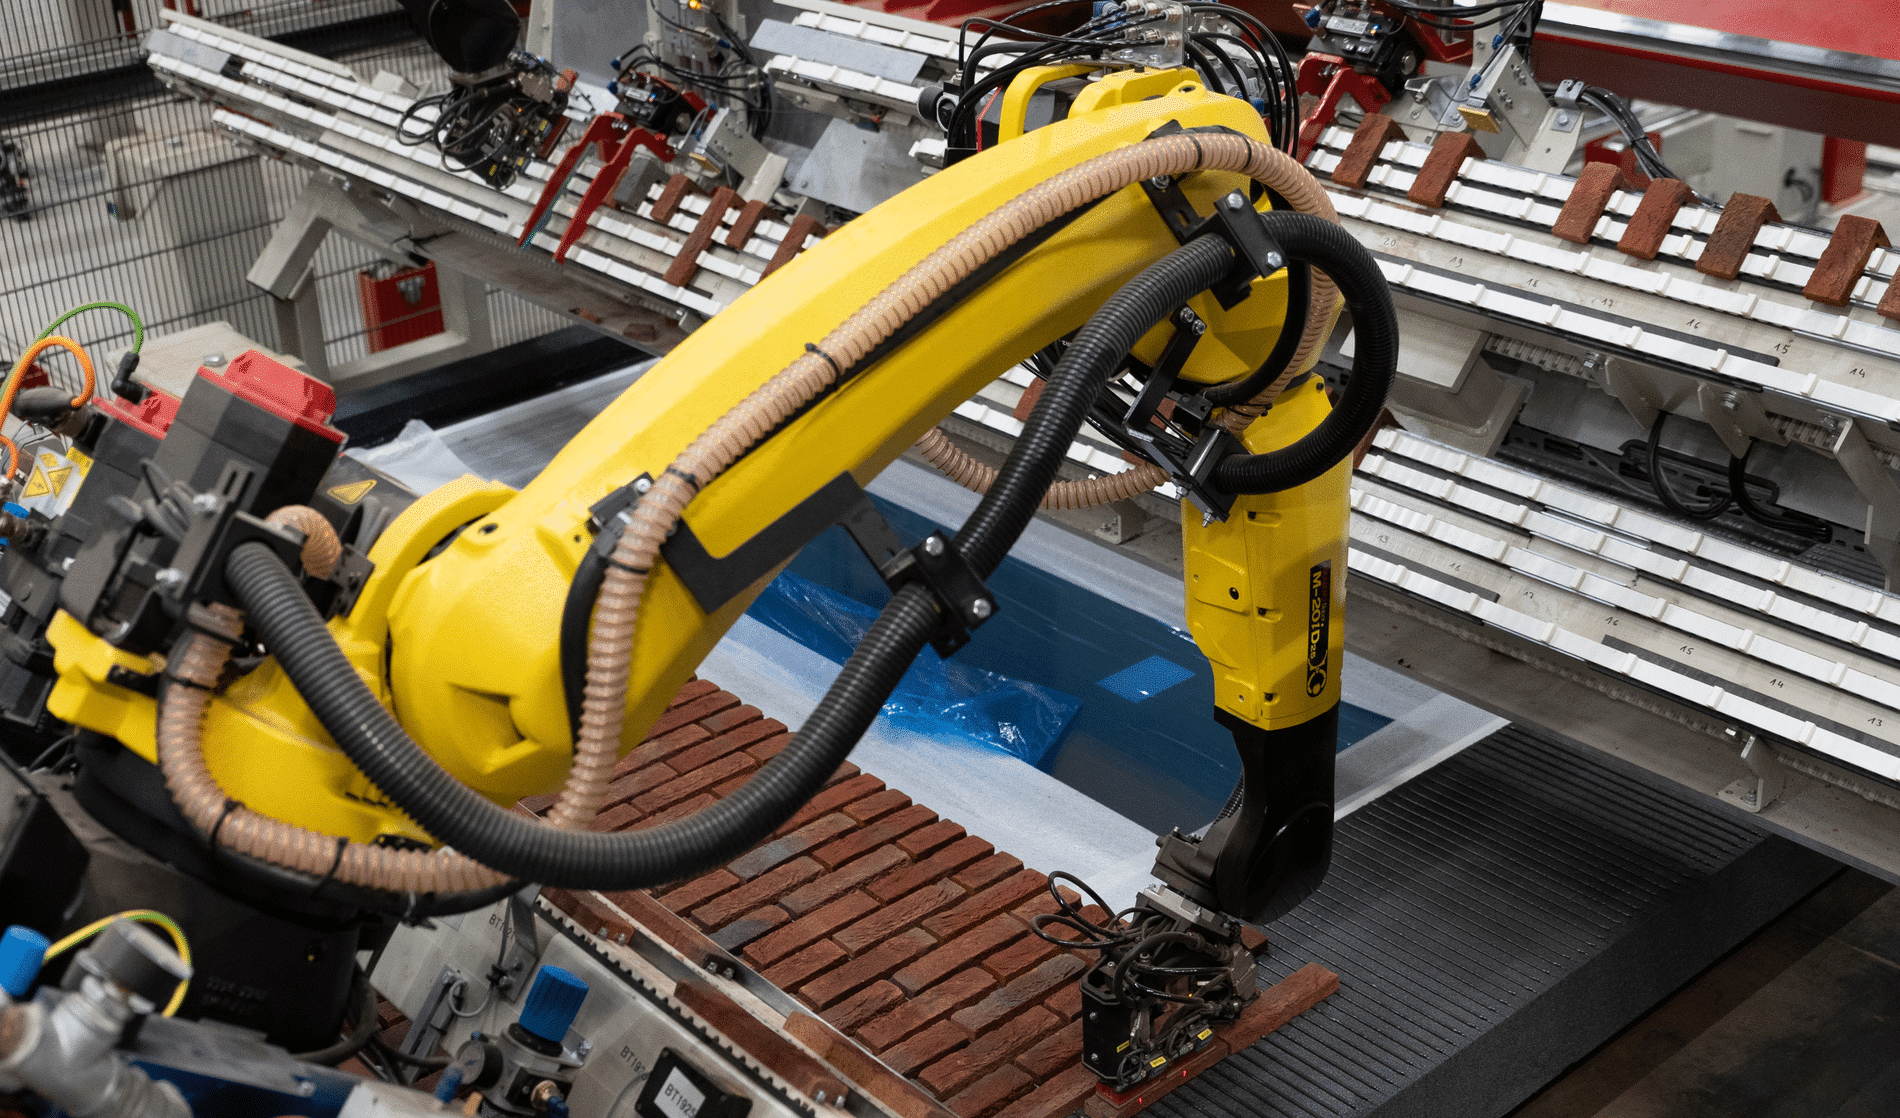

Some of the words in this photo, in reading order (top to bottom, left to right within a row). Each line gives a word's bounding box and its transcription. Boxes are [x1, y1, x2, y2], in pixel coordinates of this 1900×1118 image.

[1383, 237, 1397, 248] 20
[1450, 256, 1463, 268] 19
[1601, 298, 1614, 309] 17
[1685, 318, 1700, 330] 16
[1774, 343, 1791, 355] 15
[1849, 368, 1866, 379] 14
[1605, 615, 1620, 627] 16
[1679, 645, 1695, 656] 15
[1769, 678, 1785, 689] 14
[1867, 717, 1883, 728] 13
[489, 913, 516, 941] BT121
